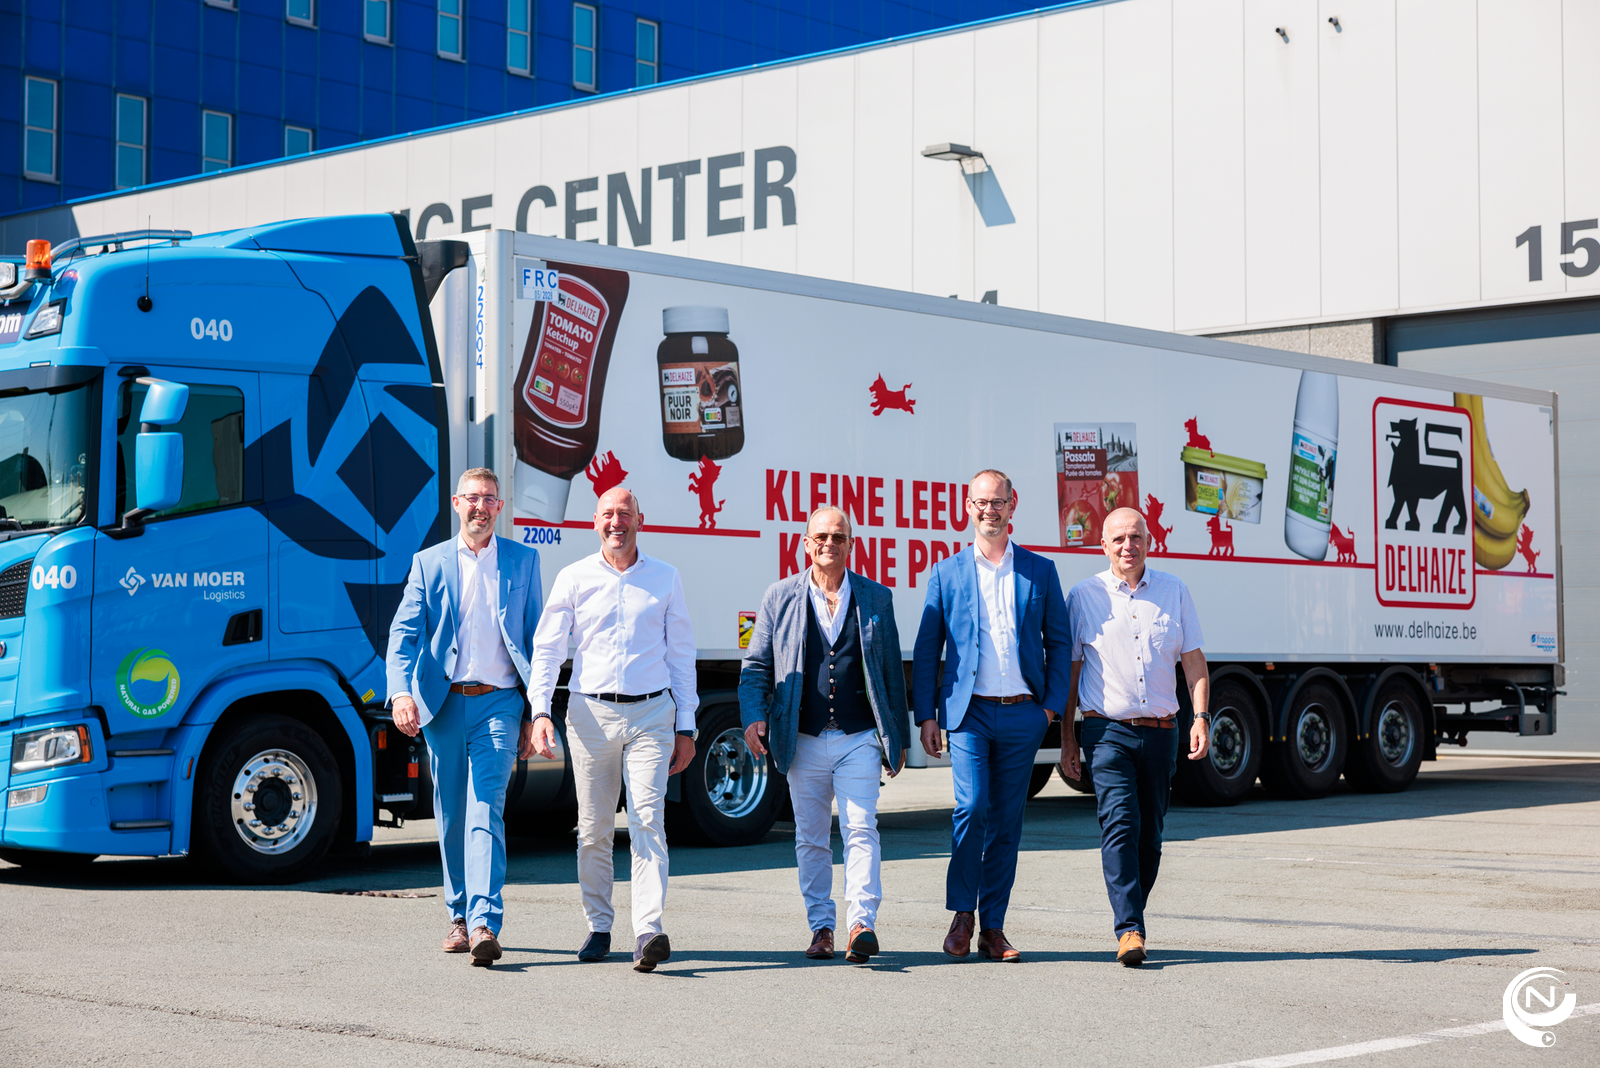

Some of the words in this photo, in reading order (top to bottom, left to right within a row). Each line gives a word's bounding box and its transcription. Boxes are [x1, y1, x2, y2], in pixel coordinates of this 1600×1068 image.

[516, 145, 797, 247] CENTER
[1515, 218, 1600, 282] 15
[523, 268, 557, 289] FRC
[566, 297, 597, 322] DELHAIZE
[190, 317, 233, 342] 040
[476, 285, 484, 370] 22004
[546, 326, 579, 351] Ketchup
[549, 311, 594, 344] TOMATO
[669, 371, 693, 382] DELHAIZE
[668, 395, 692, 408] PUUR
[670, 408, 692, 420] NOIR
[1073, 431, 1096, 443] DELHAIZE
[1064, 451, 1096, 462] Passata
[766, 468, 884, 527] KLEINE
[523, 527, 562, 545] 22004
[779, 532, 896, 588] KNE
[1385, 543, 1467, 595] DELHAIZE
[32, 564, 77, 590] 040
[152, 573, 188, 588] VAN
[193, 571, 245, 587] MOER
[203, 589, 245, 603] Logistics
[1374, 620, 1477, 640] www.delhaize.be
[119, 684, 141, 714] NATURAL
[157, 678, 177, 712] POWERED
[212, 749, 236, 829] MICHELIN
